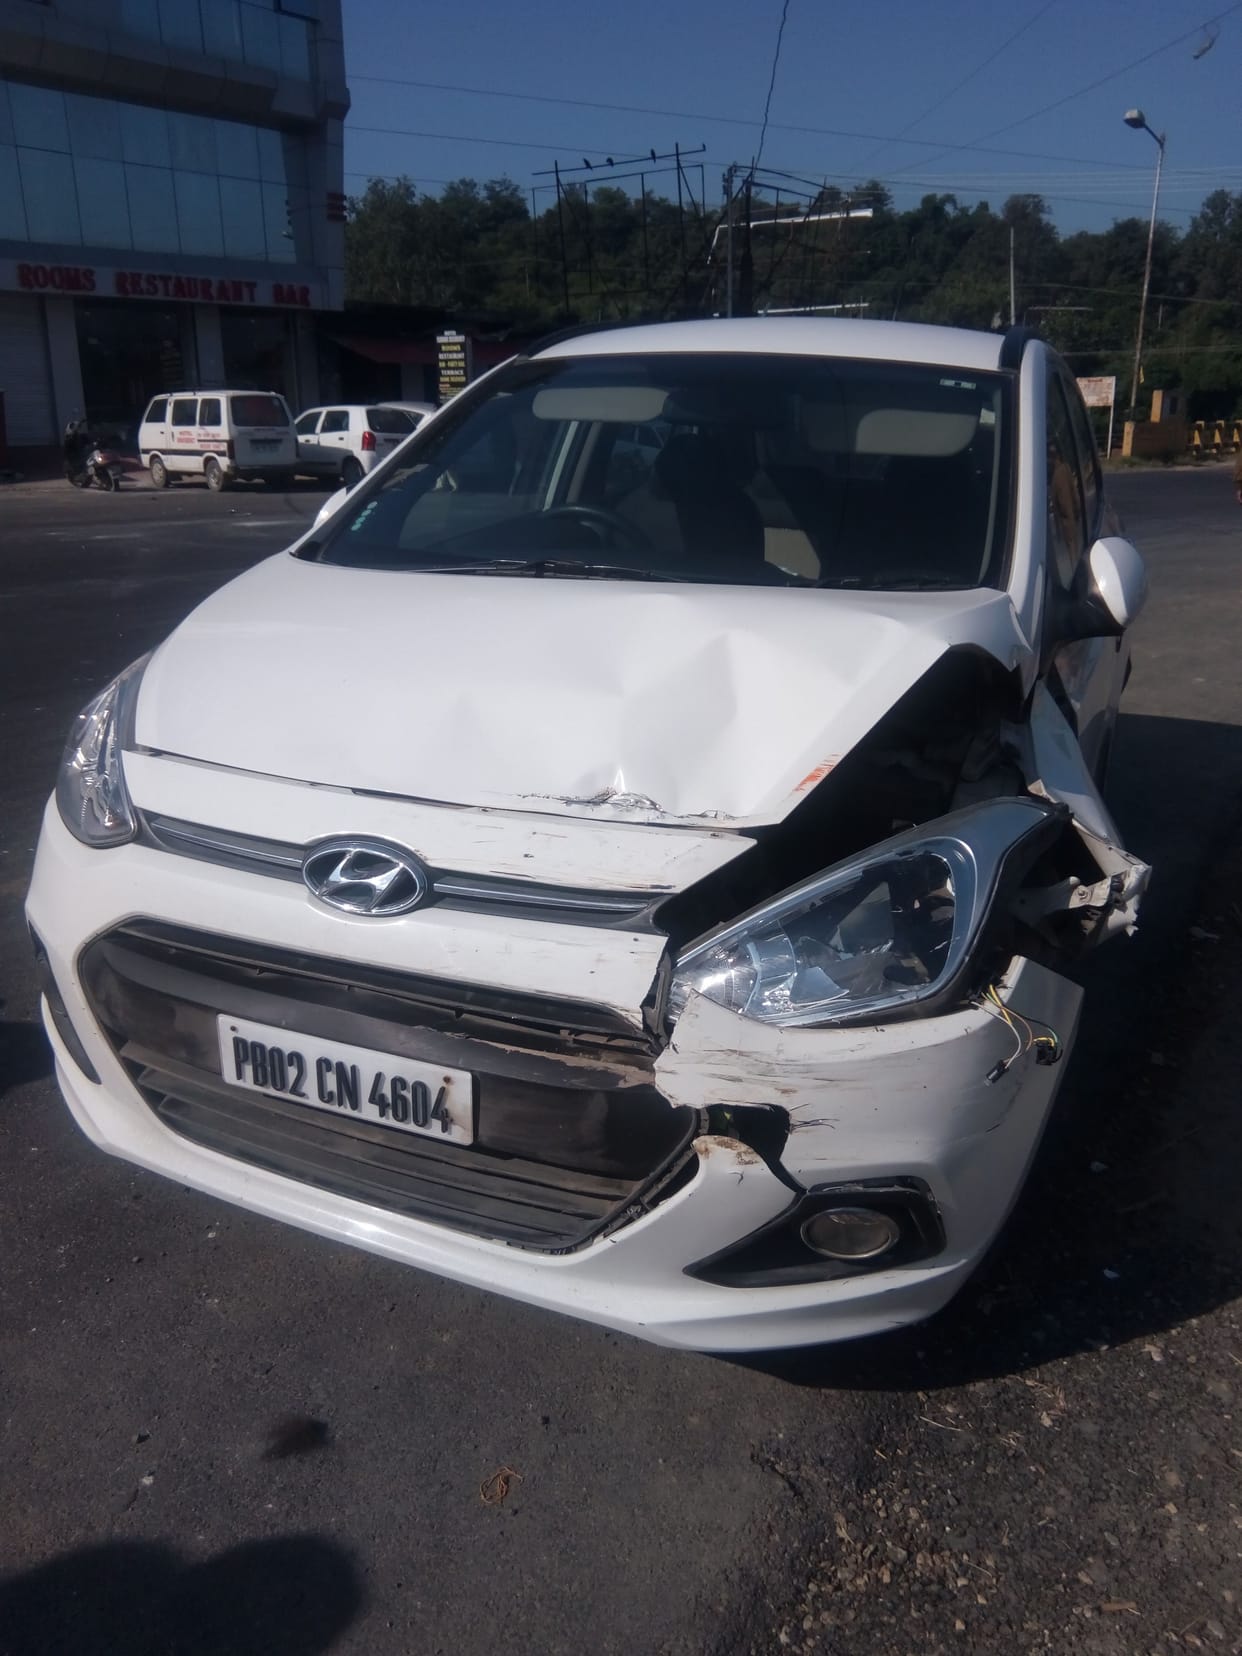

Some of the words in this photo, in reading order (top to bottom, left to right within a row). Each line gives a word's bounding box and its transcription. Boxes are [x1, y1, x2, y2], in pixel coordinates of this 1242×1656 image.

[17, 263, 97, 292] ROOMS
[114, 271, 258, 303] RESTAURANT
[272, 283, 311, 307] BAR
[232, 1036, 307, 1098] PB02
[316, 1056, 361, 1112] CN
[368, 1071, 450, 1134] 4604
